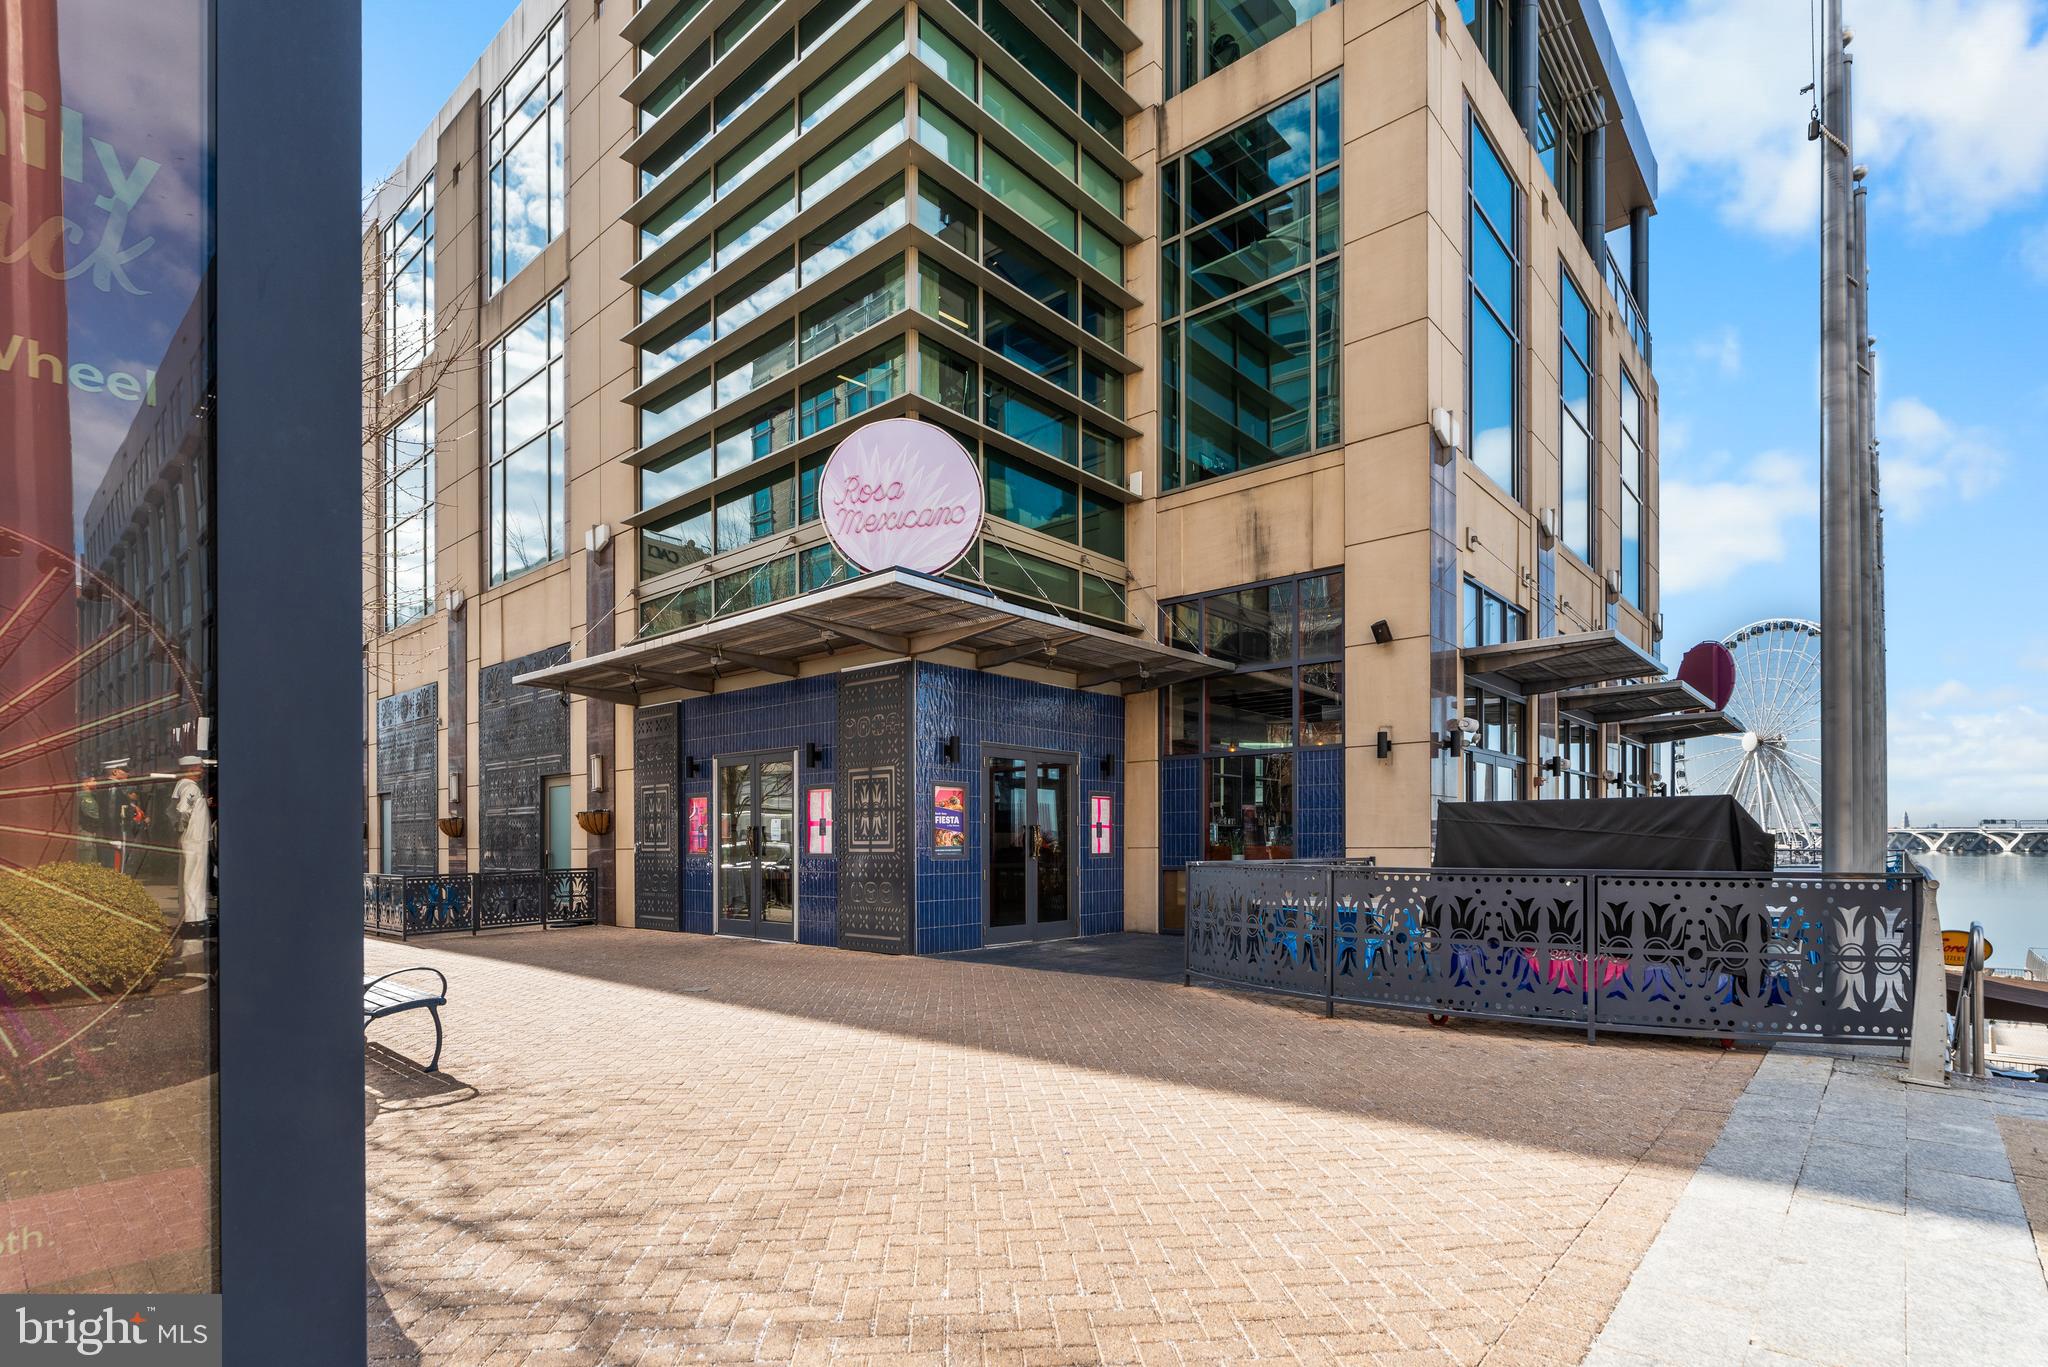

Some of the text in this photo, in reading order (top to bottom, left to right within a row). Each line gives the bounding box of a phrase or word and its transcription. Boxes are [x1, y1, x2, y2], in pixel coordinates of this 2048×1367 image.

[0, 90, 161, 213] ily
[834, 475, 905, 505] Rosa
[836, 505, 966, 535] Mexicano
[935, 816, 960, 824] FIESTA
[0, 1226, 55, 1254] th.
